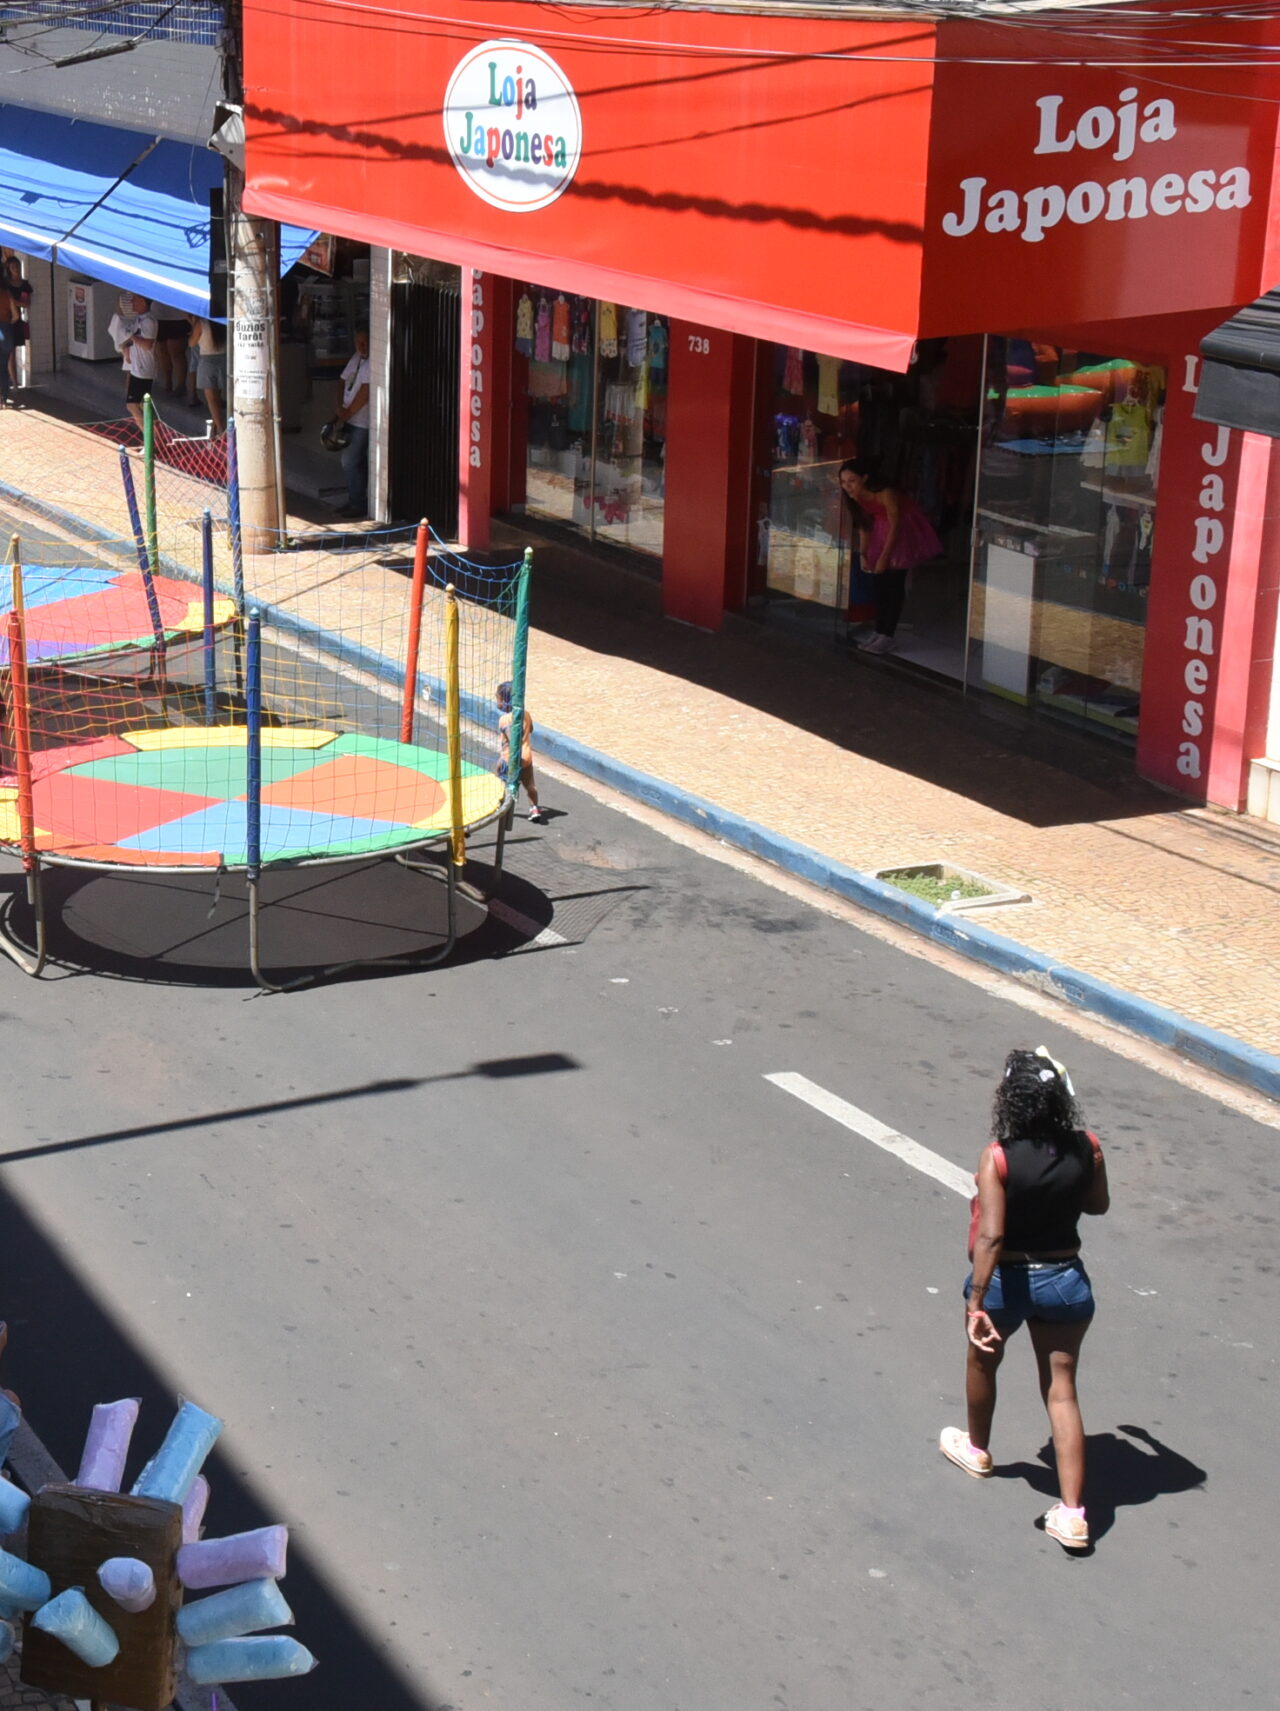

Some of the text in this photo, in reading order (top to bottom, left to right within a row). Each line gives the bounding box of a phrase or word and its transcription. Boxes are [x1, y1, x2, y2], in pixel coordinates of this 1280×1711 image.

[488, 61, 538, 121] Loja
[1033, 87, 1177, 162] Loja
[460, 111, 567, 169] Japonesa
[942, 166, 1252, 243] Japonesa
[688, 335, 710, 355] 738
[1176, 425, 1232, 779] Japonesa
